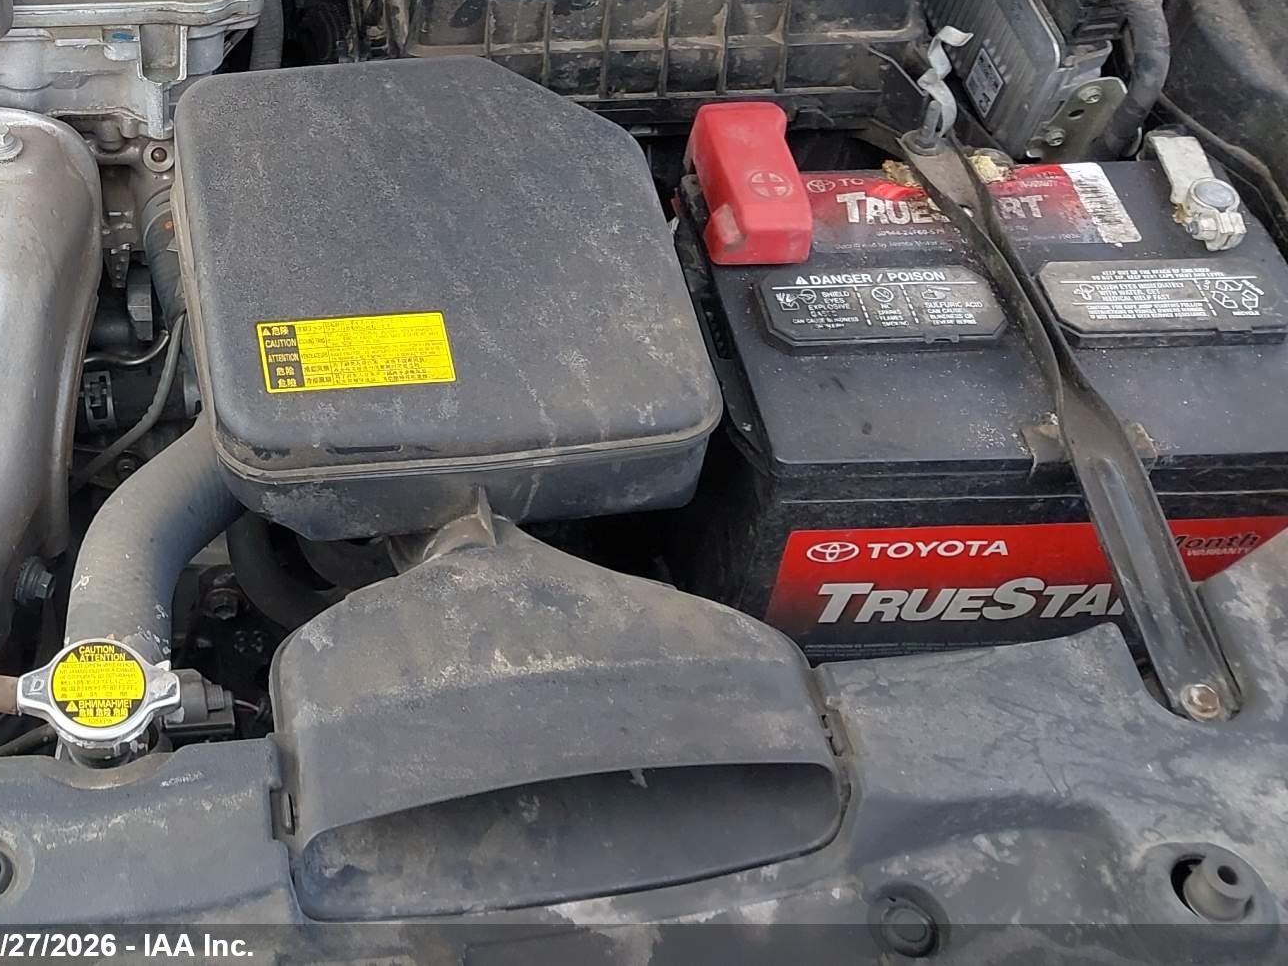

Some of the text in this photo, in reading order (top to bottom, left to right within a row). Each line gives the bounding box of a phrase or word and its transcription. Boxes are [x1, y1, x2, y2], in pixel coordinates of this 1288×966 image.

[809, 274, 873, 284] DANGER
[888, 271, 946, 282] POISON
[264, 336, 297, 348] CAUTION
[268, 353, 300, 363] ATTENTION
[867, 540, 1009, 559] TOYOTA
[816, 577, 1125, 624] TRUESTA
[78, 645, 115, 654] CAUTION
[80, 653, 126, 662] ATTENTION
[78, 700, 132, 709] ВНИМАНИЕ!
